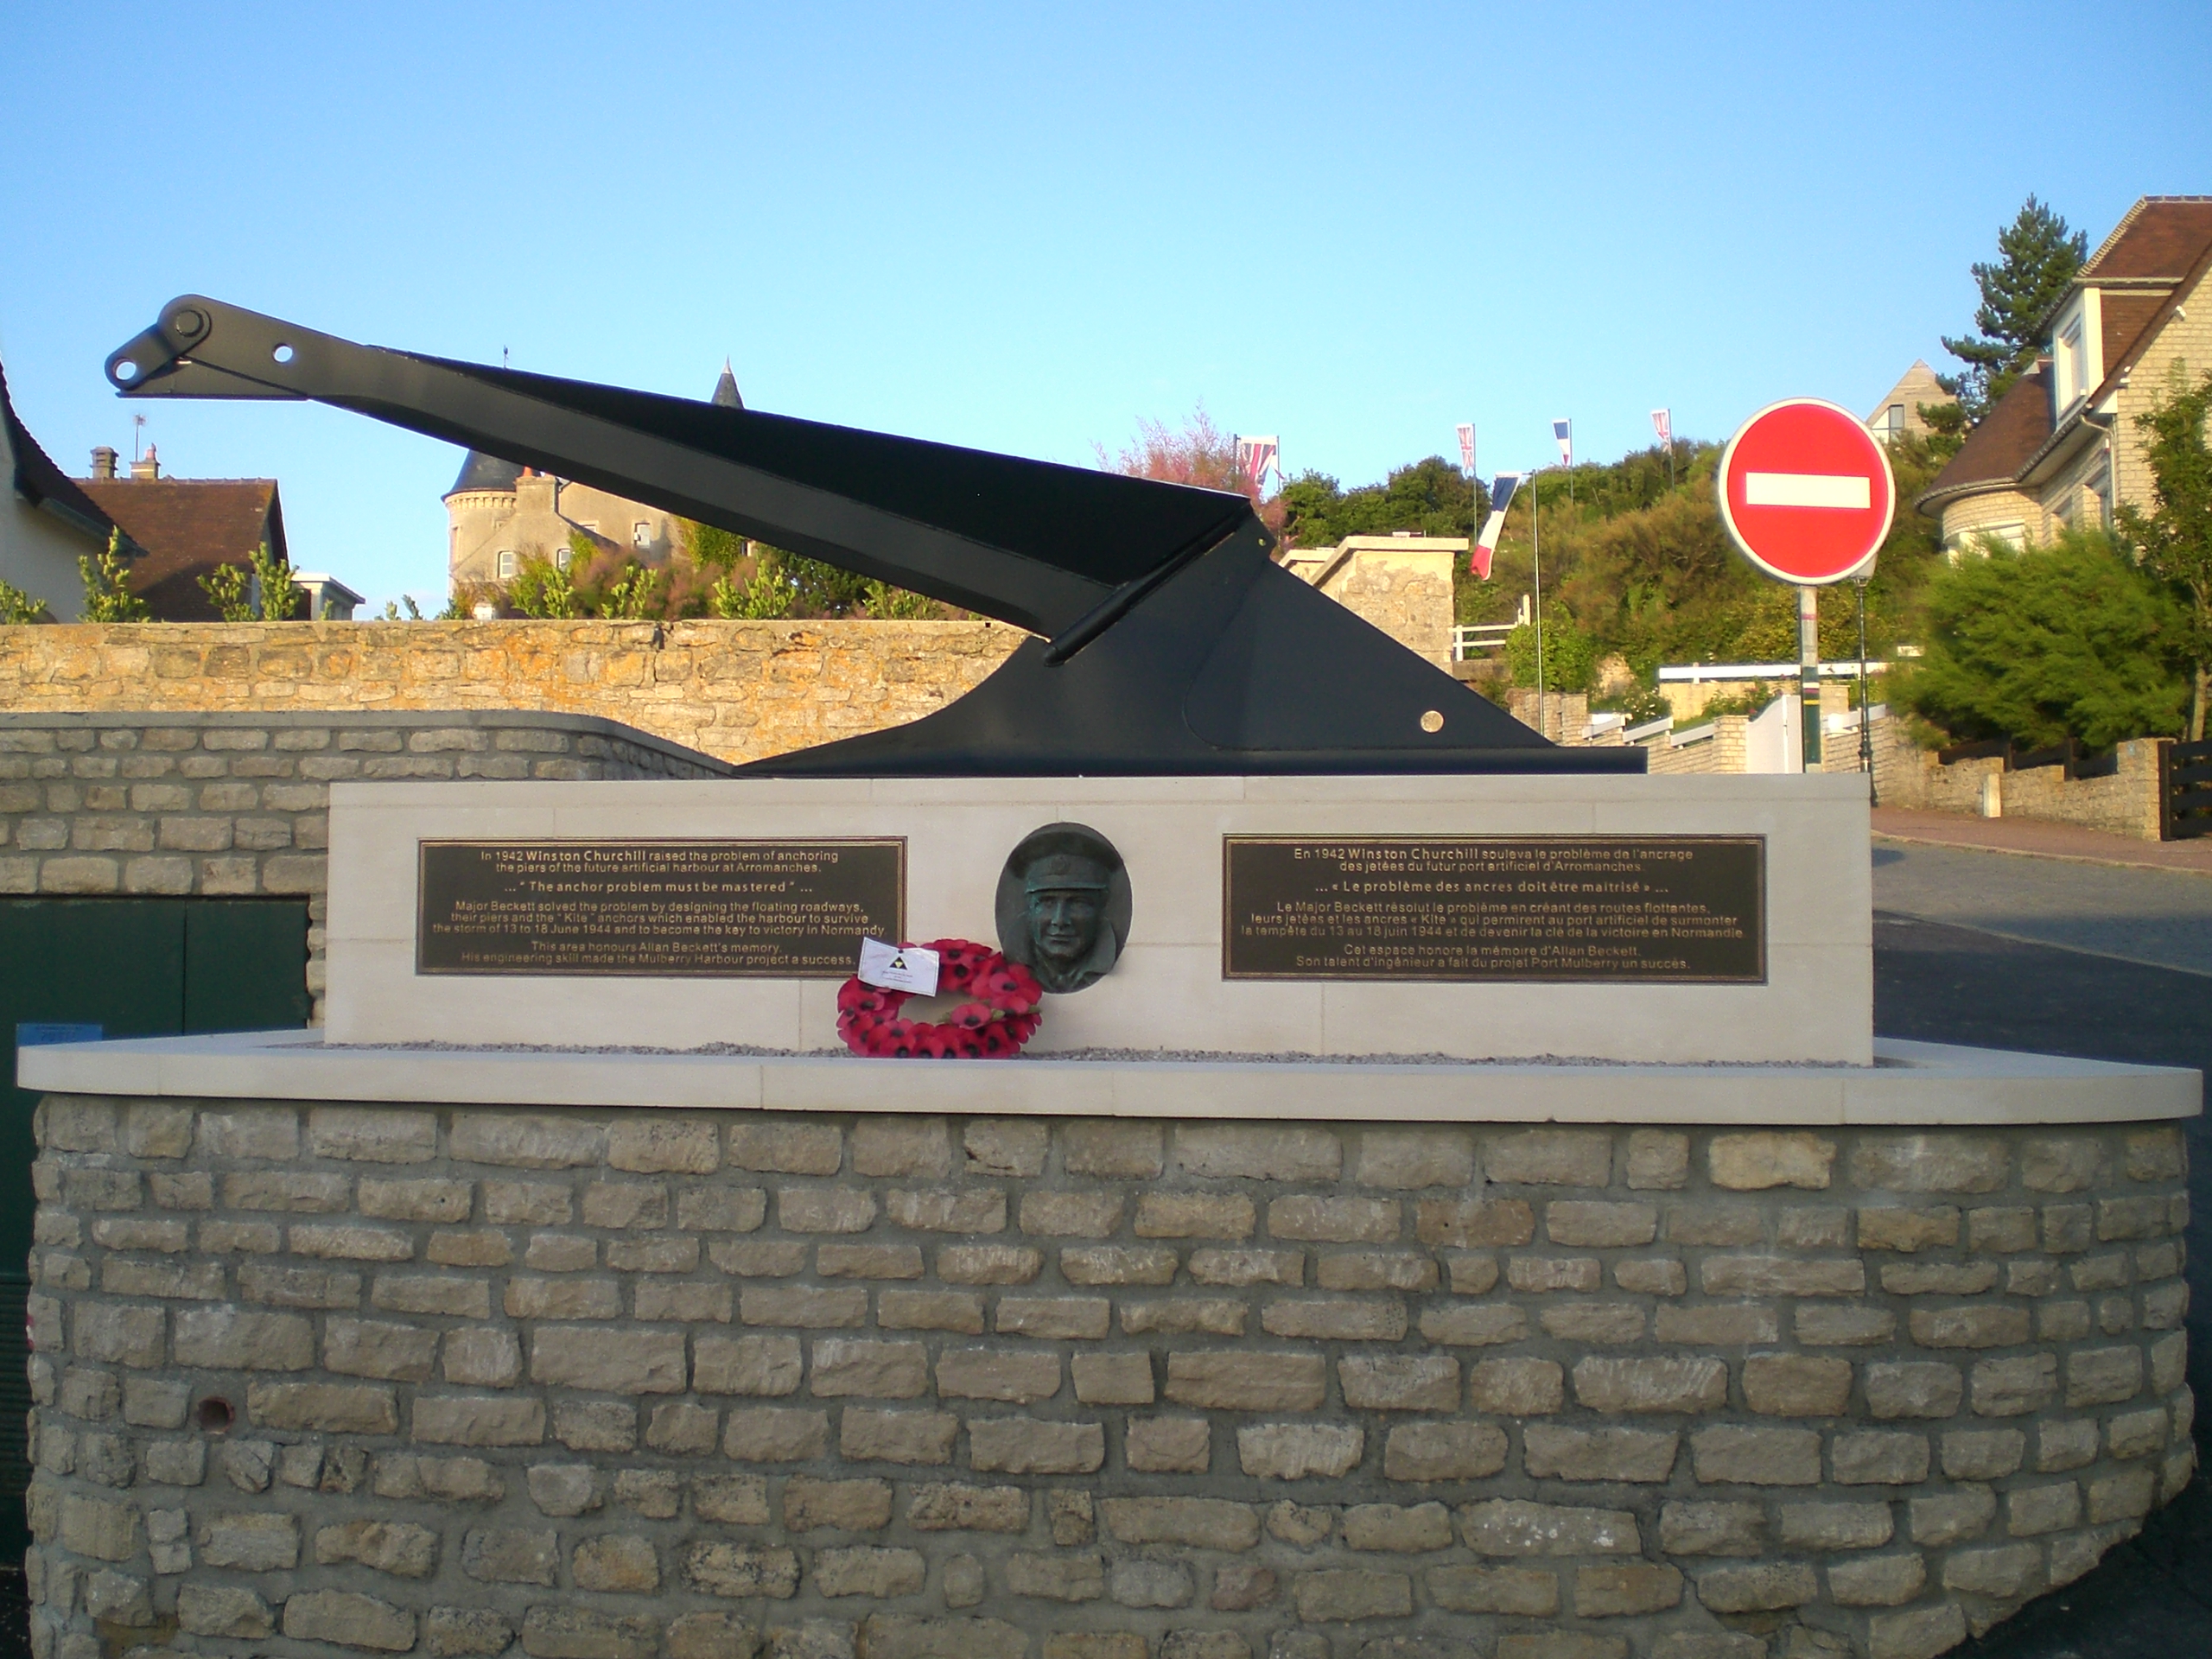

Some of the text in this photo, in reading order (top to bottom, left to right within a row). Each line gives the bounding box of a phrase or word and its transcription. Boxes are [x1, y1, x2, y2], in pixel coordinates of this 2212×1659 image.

[480, 850, 838, 863] In 1942 Winston Churchill raised the problem of anchoring
[1294, 849, 1310, 859] En
[1314, 849, 1345, 859] 1942
[1348, 849, 1408, 860] Winston
[1411, 849, 1478, 860] Churchill
[1482, 849, 1532, 859] souleva
[1535, 849, 1546, 859] le
[1549, 849, 1611, 861] problème
[1614, 849, 1630, 860] de
[496, 862, 822, 874] the piers of the future artificial harbour at Arromanches.
[1339, 861, 1363, 872] des
[1408, 861, 1423, 872] du
[1427, 861, 1456, 872] futur
[1459, 862, 1484, 873] port
[1487, 861, 1540, 872] artificiel
[529, 881, 786, 893] The anchor problem must be mastered
[1344, 881, 1360, 892] Le
[1363, 880, 1432, 894] problème
[1436, 881, 1459, 892] des
[1465, 883, 1513, 892] ancres
[1518, 881, 1548, 893] doit
[455, 900, 798, 914] Major Beckett solved the problem by designing the floating
[1277, 902, 1293, 912] Le
[1295, 902, 1331, 914] Major
[1334, 902, 1382, 912] Beckett
[1433, 903, 1444, 912] le
[1447, 902, 1508, 915] problème
[1510, 905, 1527, 913] en
[1574, 902, 1597, 912] des
[1600, 903, 1642, 913] routes
[451, 912, 868, 924] their piers and the anchors which enabled the harbour to survive
[1251, 913, 1282, 924] leurs
[1327, 914, 1340, 924] et
[1343, 913, 1361, 924] les
[1364, 916, 1408, 925] ancres
[1460, 914, 1480, 926] qui
[1483, 915, 1545, 927] permirent
[1567, 916, 1593, 928] port
[1596, 915, 1649, 926] artificiel
[1651, 916, 1668, 926] de
[1671, 916, 1738, 926] surmonter
[432, 924, 817, 938] the storm of 13 to 18 June 1944 and to become the key to victory in
[1241, 925, 1252, 936] la
[1310, 926, 1325, 936] du
[1329, 926, 1344, 936] 13
[1346, 928, 1363, 937] au
[1367, 926, 1382, 937] 18
[1384, 925, 1408, 938] juin
[1411, 927, 1442, 937] 1944
[1446, 927, 1458, 938] et
[1460, 927, 1477, 938] de
[1479, 926, 1529, 938] devenir
[1530, 927, 1542, 938] la
[1567, 928, 1583, 938] de
[1586, 928, 1598, 938] la
[1601, 928, 1649, 938] victoire
[531, 941, 556, 951] This
[559, 943, 586, 952] area
[588, 942, 637, 952] honours
[639, 942, 669, 952] Allan
[1344, 944, 1366, 955] Cet
[1370, 946, 1415, 957] espace
[1418, 945, 1464, 956] honore
[1466, 945, 1478, 956] la
[483, 953, 553, 965] engineering
[556, 953, 579, 963] skill
[582, 954, 614, 963] made
[617, 954, 636, 963] the
[639, 954, 691, 966] Mulberry
[695, 954, 743, 964] Harbour
[747, 956, 789, 966] project
[1296, 957, 1321, 966] Son
[1324, 957, 1360, 967] talent
[1448, 957, 1469, 968] fait
[1471, 957, 1487, 968] du
[1491, 958, 1529, 969] projet
[1531, 958, 1559, 968] Port
[1561, 958, 1618, 969] Mulberry
[1622, 961, 1637, 969] un
